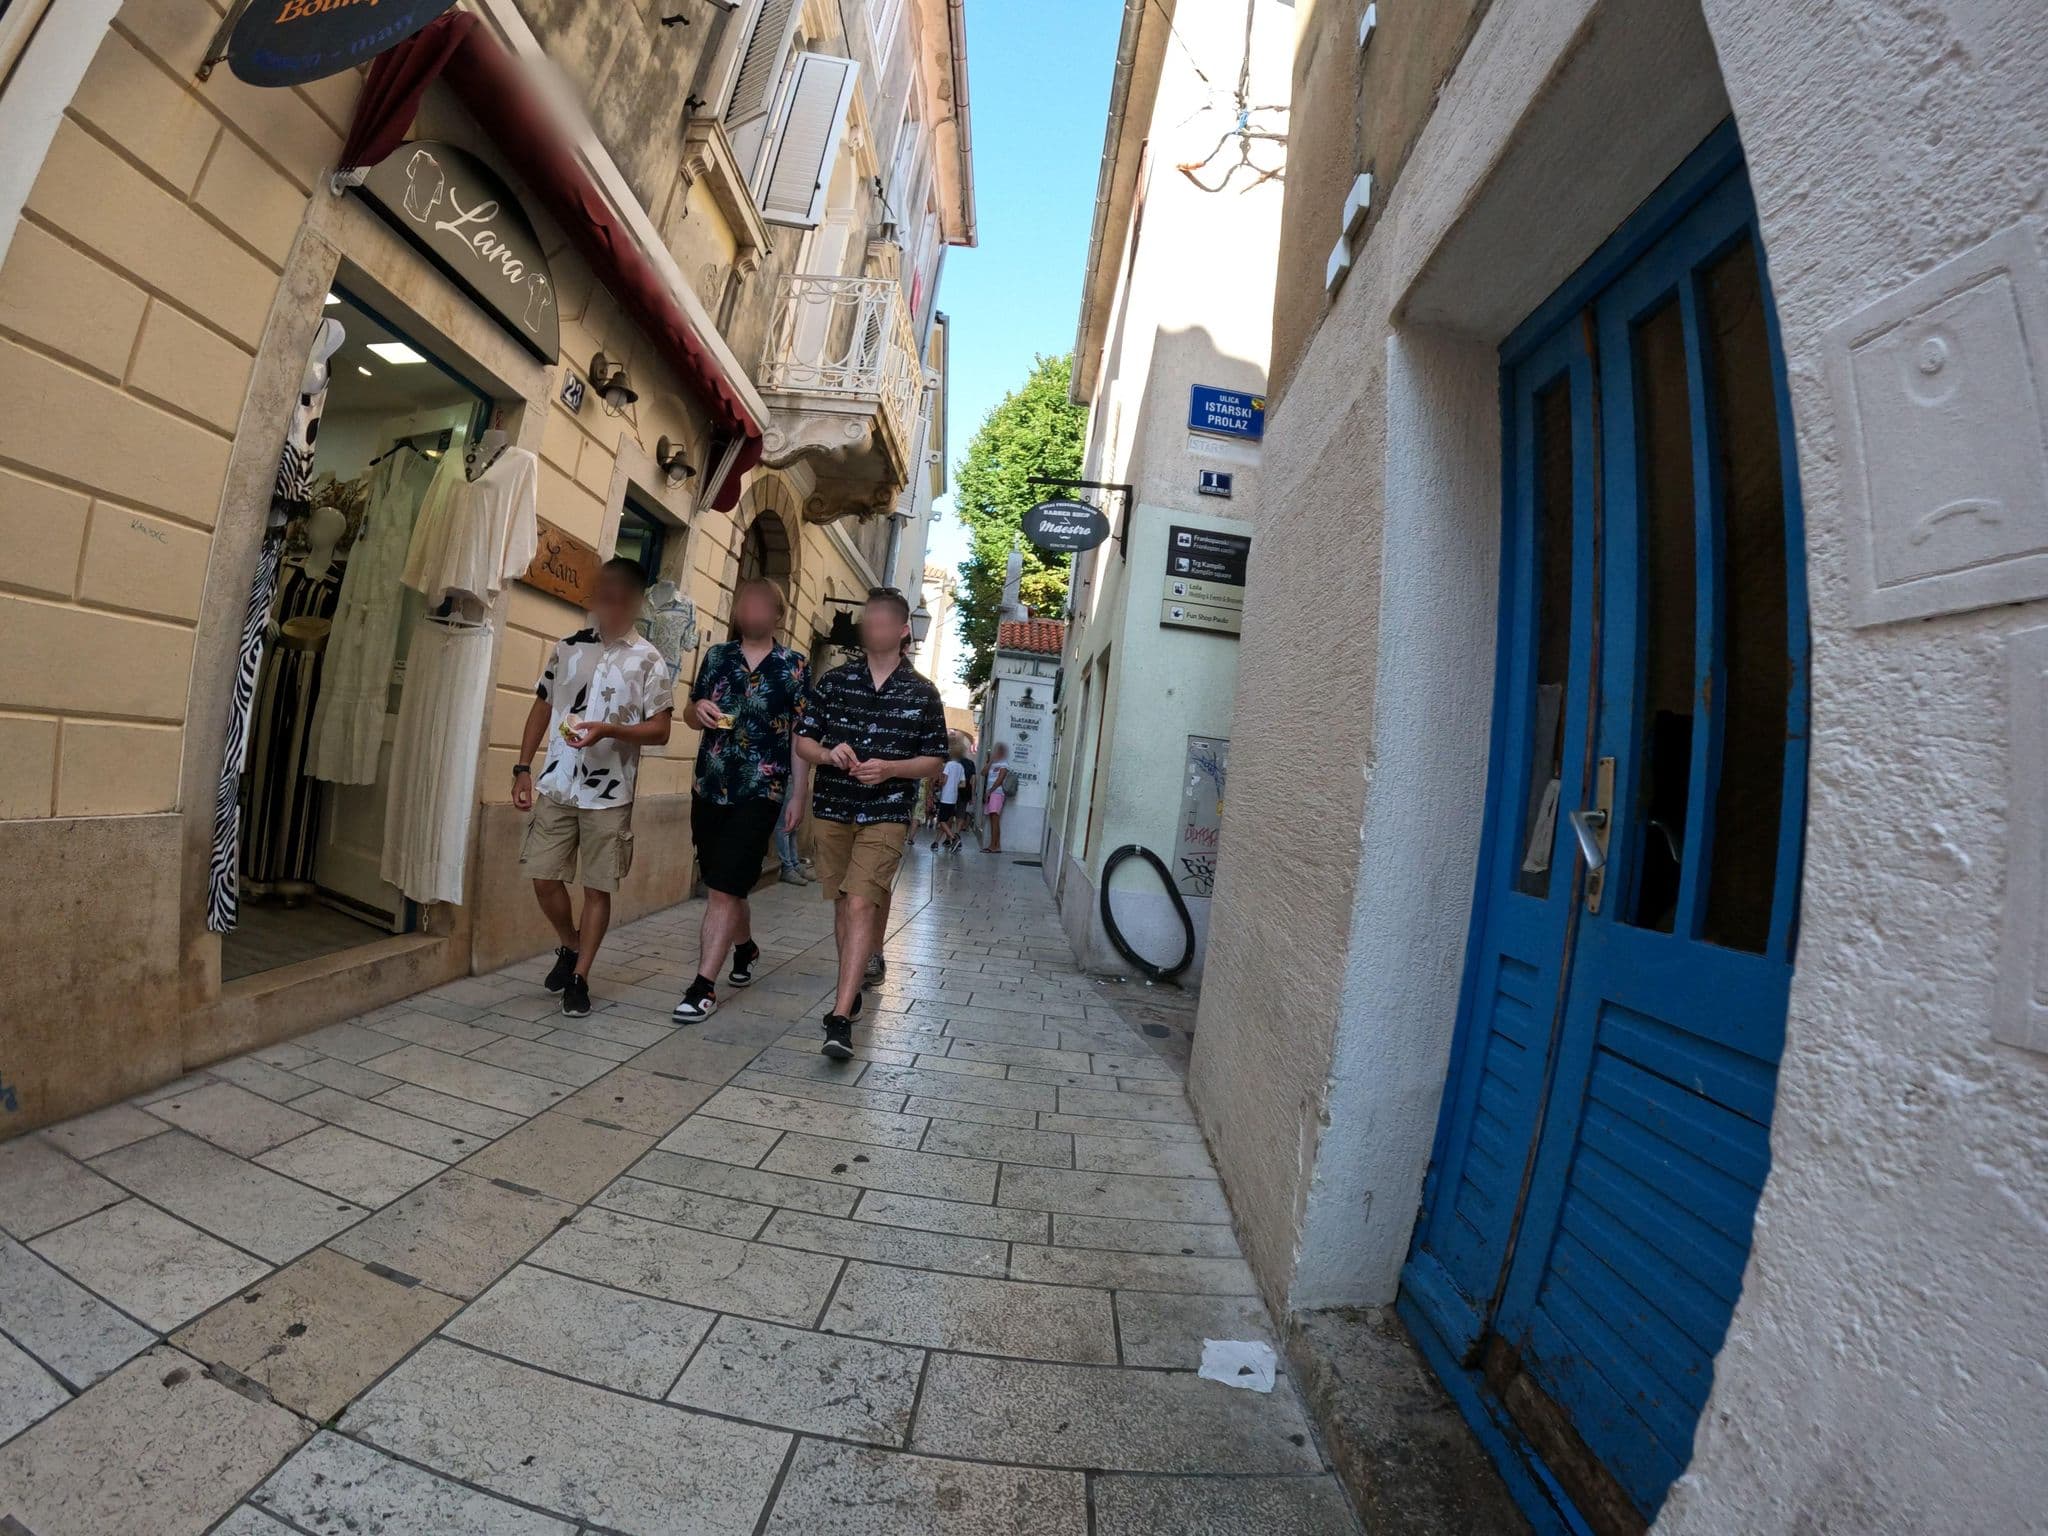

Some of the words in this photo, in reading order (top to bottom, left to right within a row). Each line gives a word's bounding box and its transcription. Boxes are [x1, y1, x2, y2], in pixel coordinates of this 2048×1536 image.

[435, 186, 525, 284] Lara
[565, 376, 583, 406] 23
[1219, 395, 1240, 405] ULICA
[1205, 401, 1252, 419] ISTARSKI
[1207, 414, 1248, 430] PROLAZ
[1211, 473, 1218, 486] 1
[1039, 520, 1091, 536] Maestro
